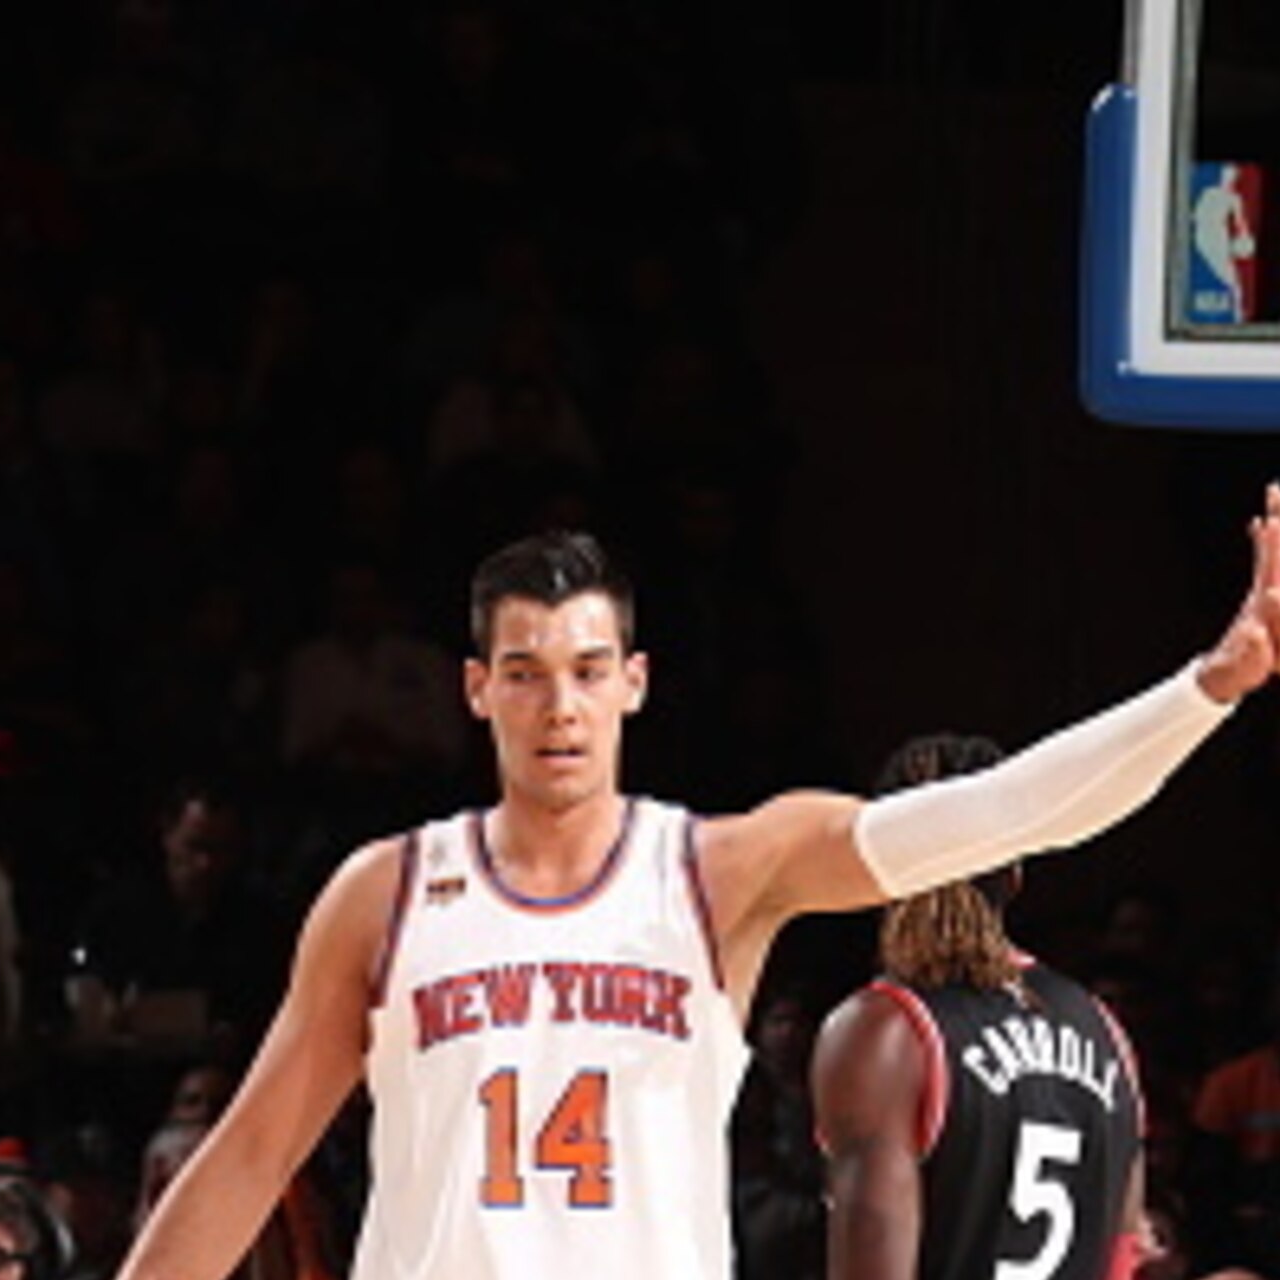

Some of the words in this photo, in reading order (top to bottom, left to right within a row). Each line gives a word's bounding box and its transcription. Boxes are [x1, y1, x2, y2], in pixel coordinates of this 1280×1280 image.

[412, 962, 536, 1052] NEW
[542, 960, 691, 1041] YORK
[477, 1066, 613, 1209] 14
